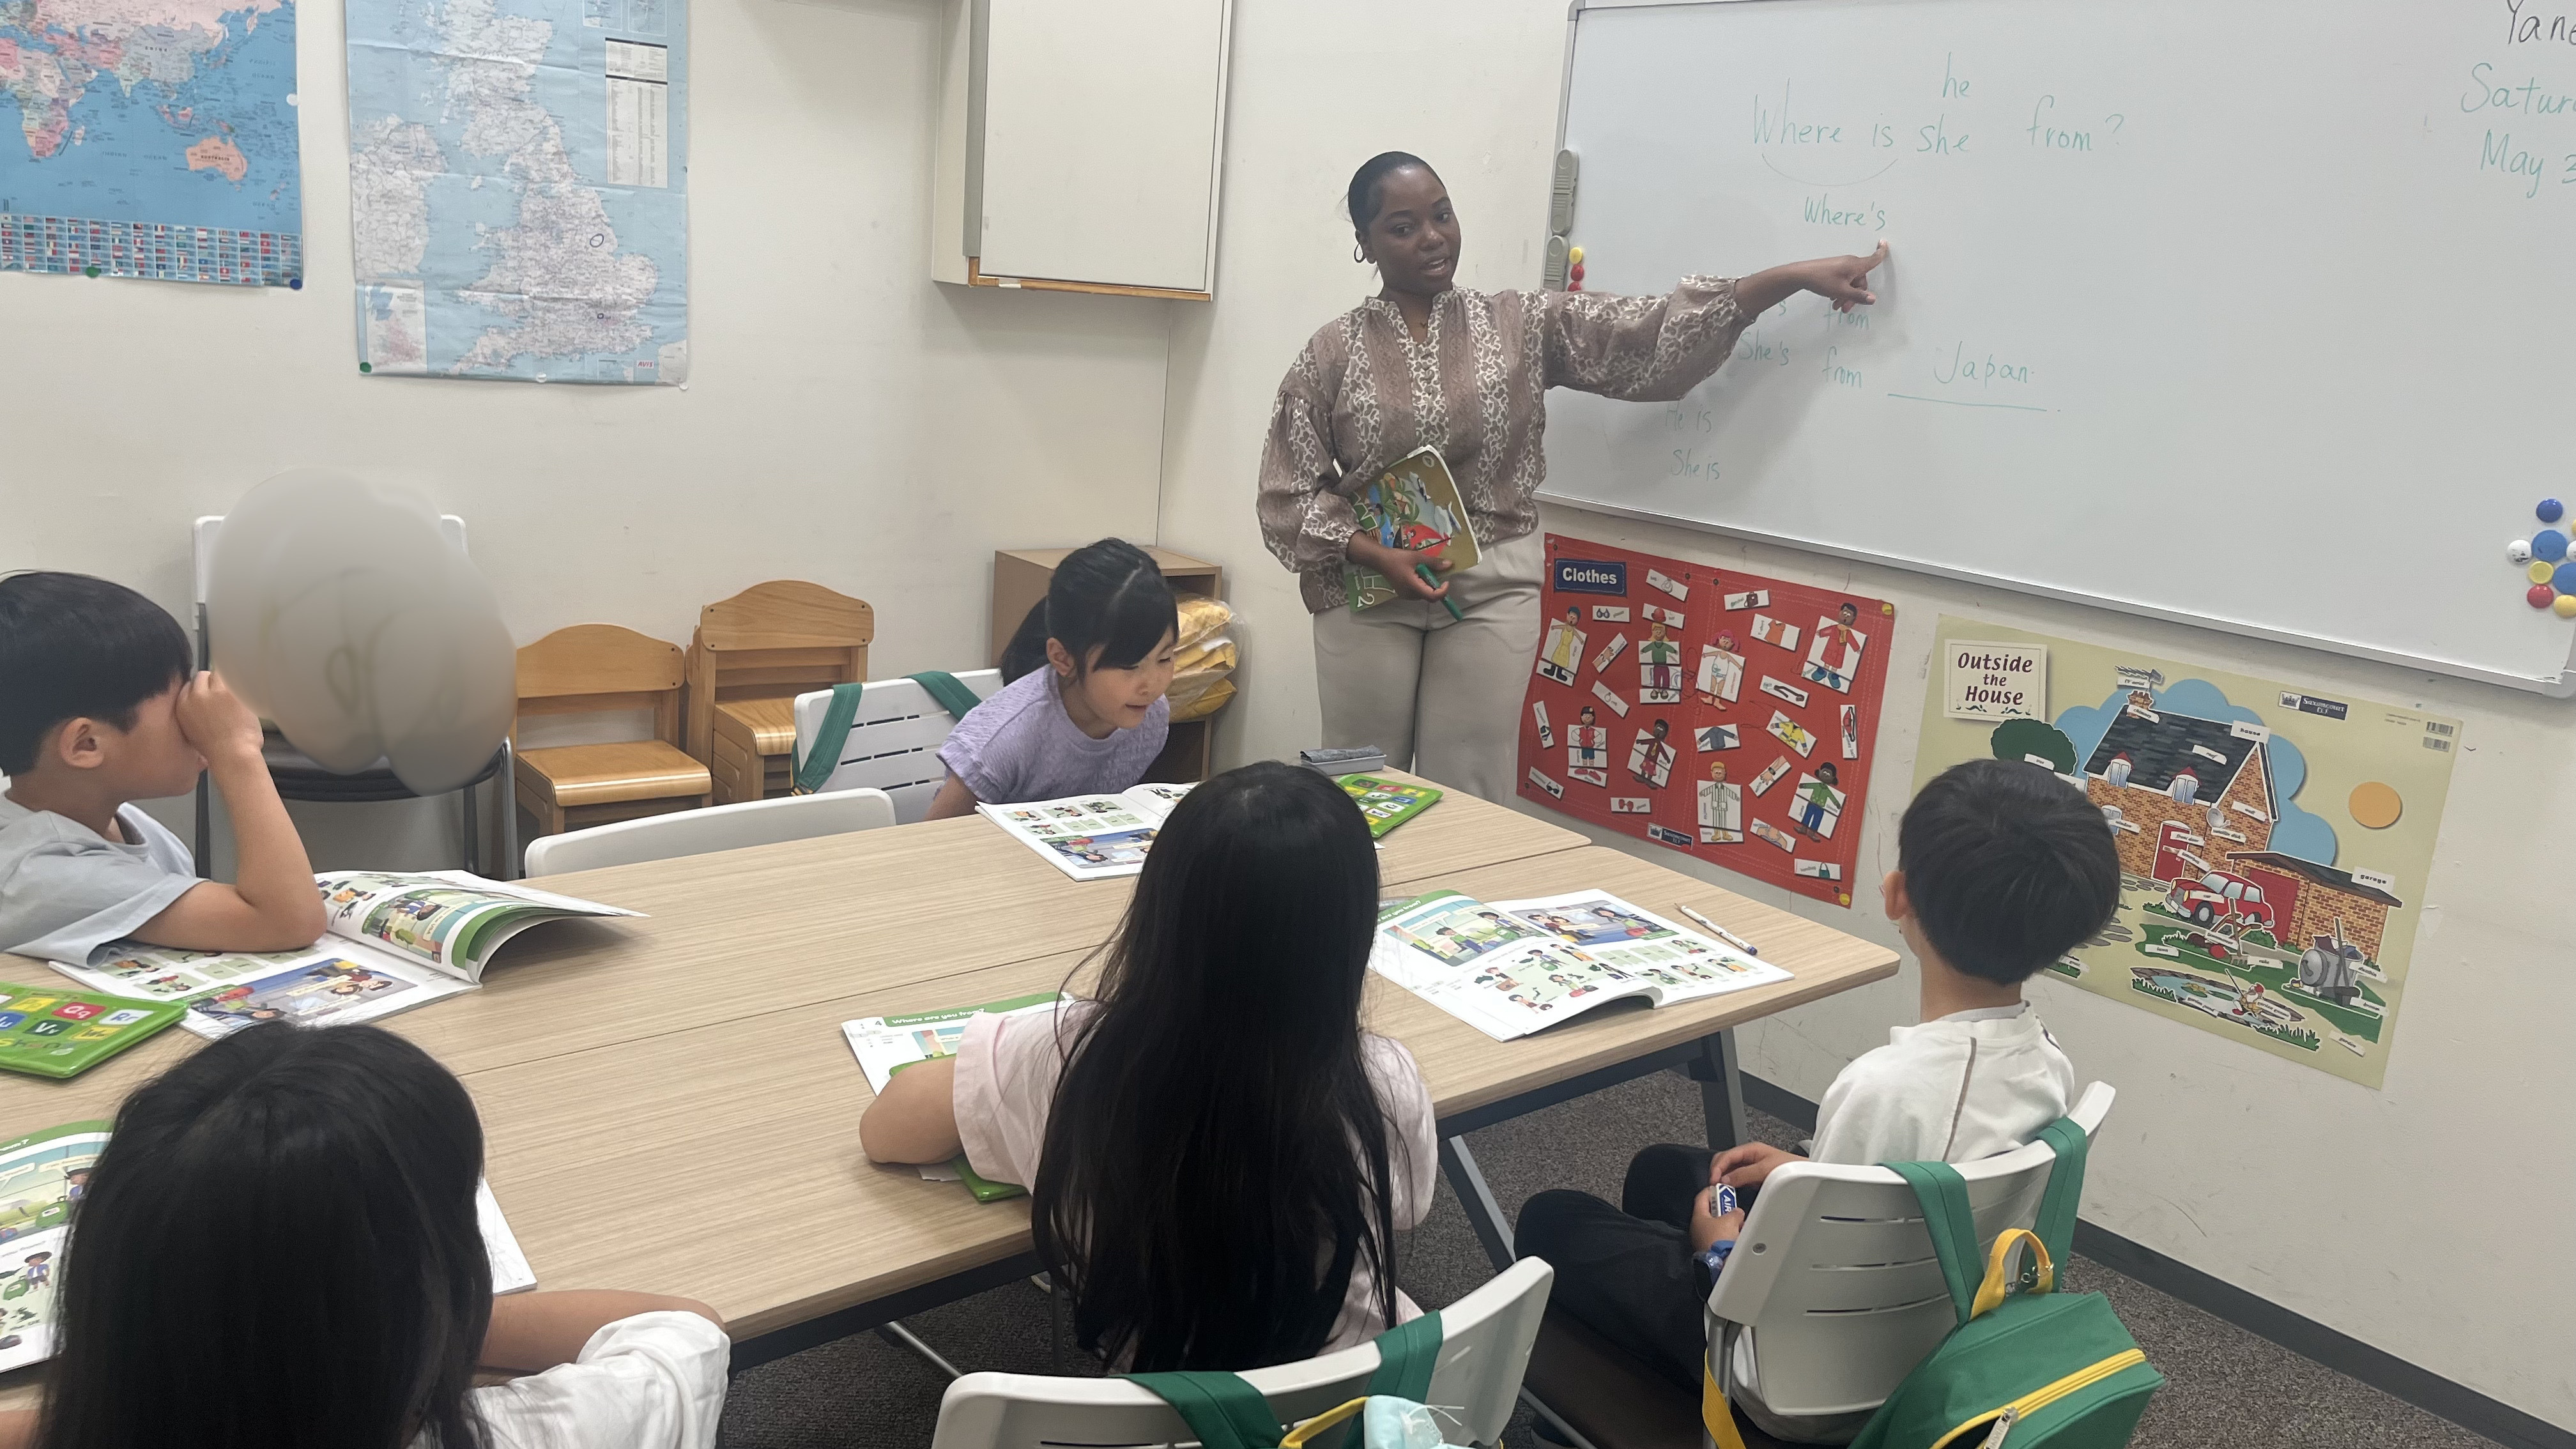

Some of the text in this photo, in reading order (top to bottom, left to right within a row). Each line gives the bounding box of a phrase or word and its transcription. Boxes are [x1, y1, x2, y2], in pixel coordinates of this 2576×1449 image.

[1943, 51, 1970, 98] he
[2462, 63, 2576, 114] Satur
[1754, 77, 1842, 144] Where
[1873, 112, 1894, 148] is
[2481, 128, 2543, 198] May
[1804, 193, 1885, 231] Where's
[1737, 328, 1790, 366] She's
[1821, 346, 1862, 388] from
[1696, 405, 1712, 433] is
[1671, 448, 1721, 482] She is
[1562, 567, 1618, 585] Clothes
[1357, 592, 1375, 608] 2
[1958, 652, 2033, 673] Outside
[1983, 673, 2007, 686] the
[1965, 686, 2023, 705] House
[2360, 873, 2388, 885] garage
[64, 1005, 91, 1019] Qq
[110, 1013, 139, 1022] Rr
[35, 1022, 60, 1034] Vv
